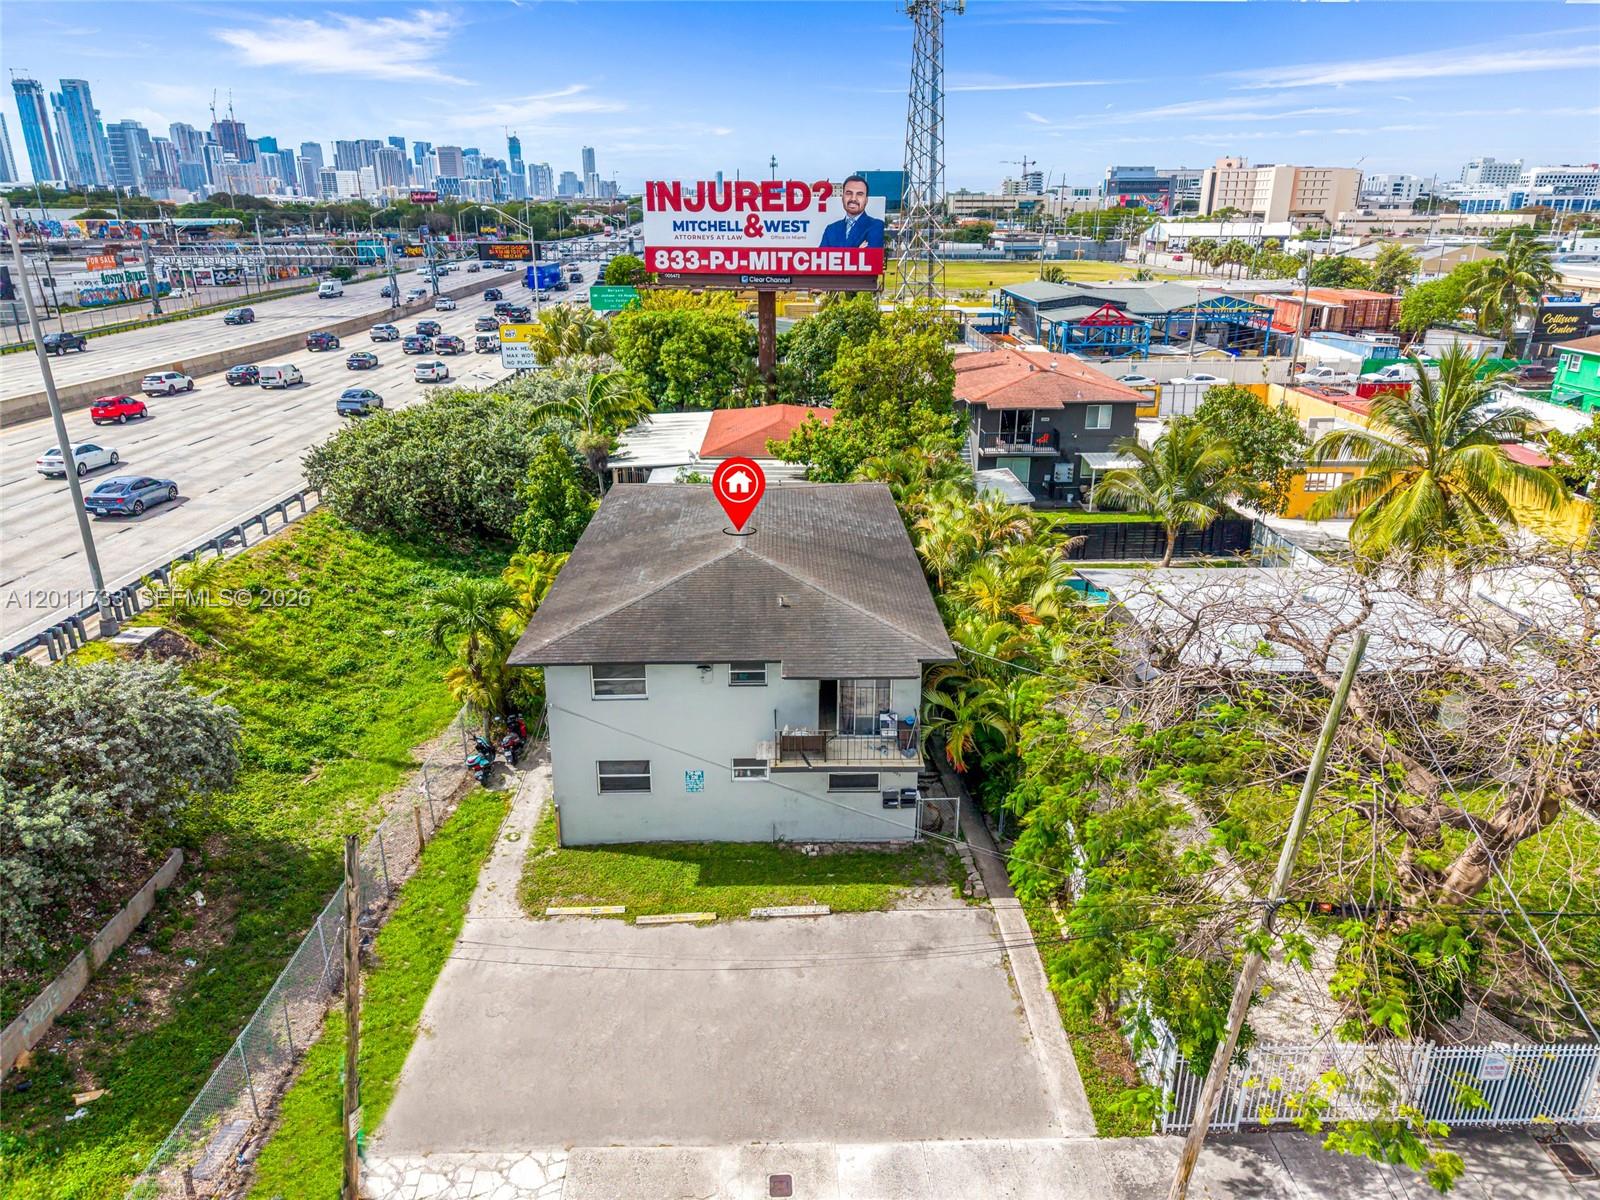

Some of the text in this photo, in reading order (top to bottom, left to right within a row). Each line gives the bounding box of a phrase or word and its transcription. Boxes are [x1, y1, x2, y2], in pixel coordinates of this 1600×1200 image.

[646, 180, 833, 213] INJURED?
[673, 213, 810, 238] MITCHELL & WEST
[86, 255, 116, 265] FOR SALE
[654, 250, 872, 271] 833-PJ-MITCHELL
[1542, 313, 1580, 324] Collision
[1547, 324, 1578, 334] Center
